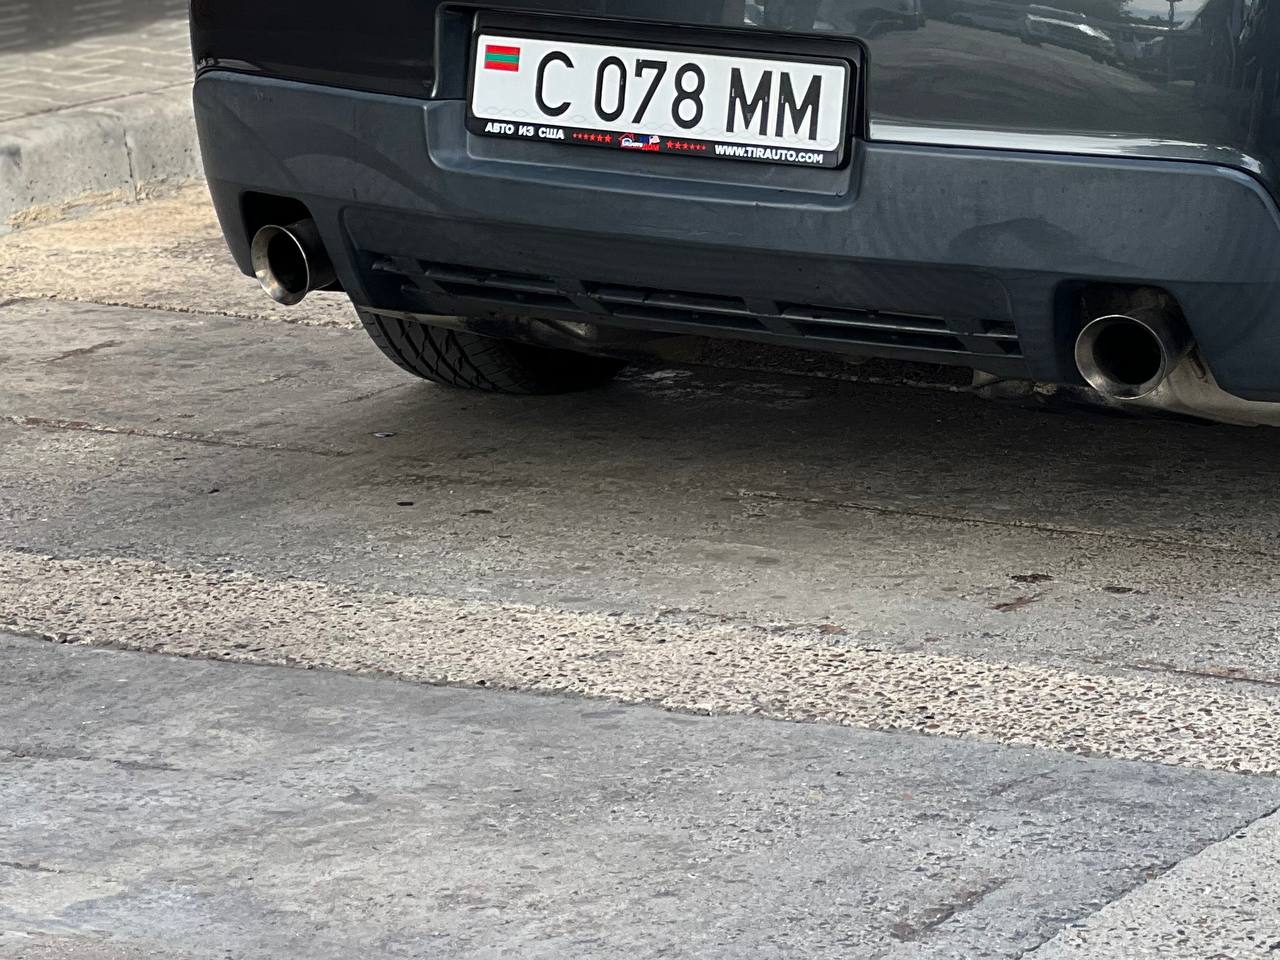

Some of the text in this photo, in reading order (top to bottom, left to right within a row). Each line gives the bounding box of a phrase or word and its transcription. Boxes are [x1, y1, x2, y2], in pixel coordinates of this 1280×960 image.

[535, 50, 823, 141] C 078 MM
[485, 122, 515, 135] АВТО
[518, 125, 534, 137] ИЗ
[538, 127, 565, 140] США
[714, 144, 824, 164] WWW.TIRAUTO.COM
